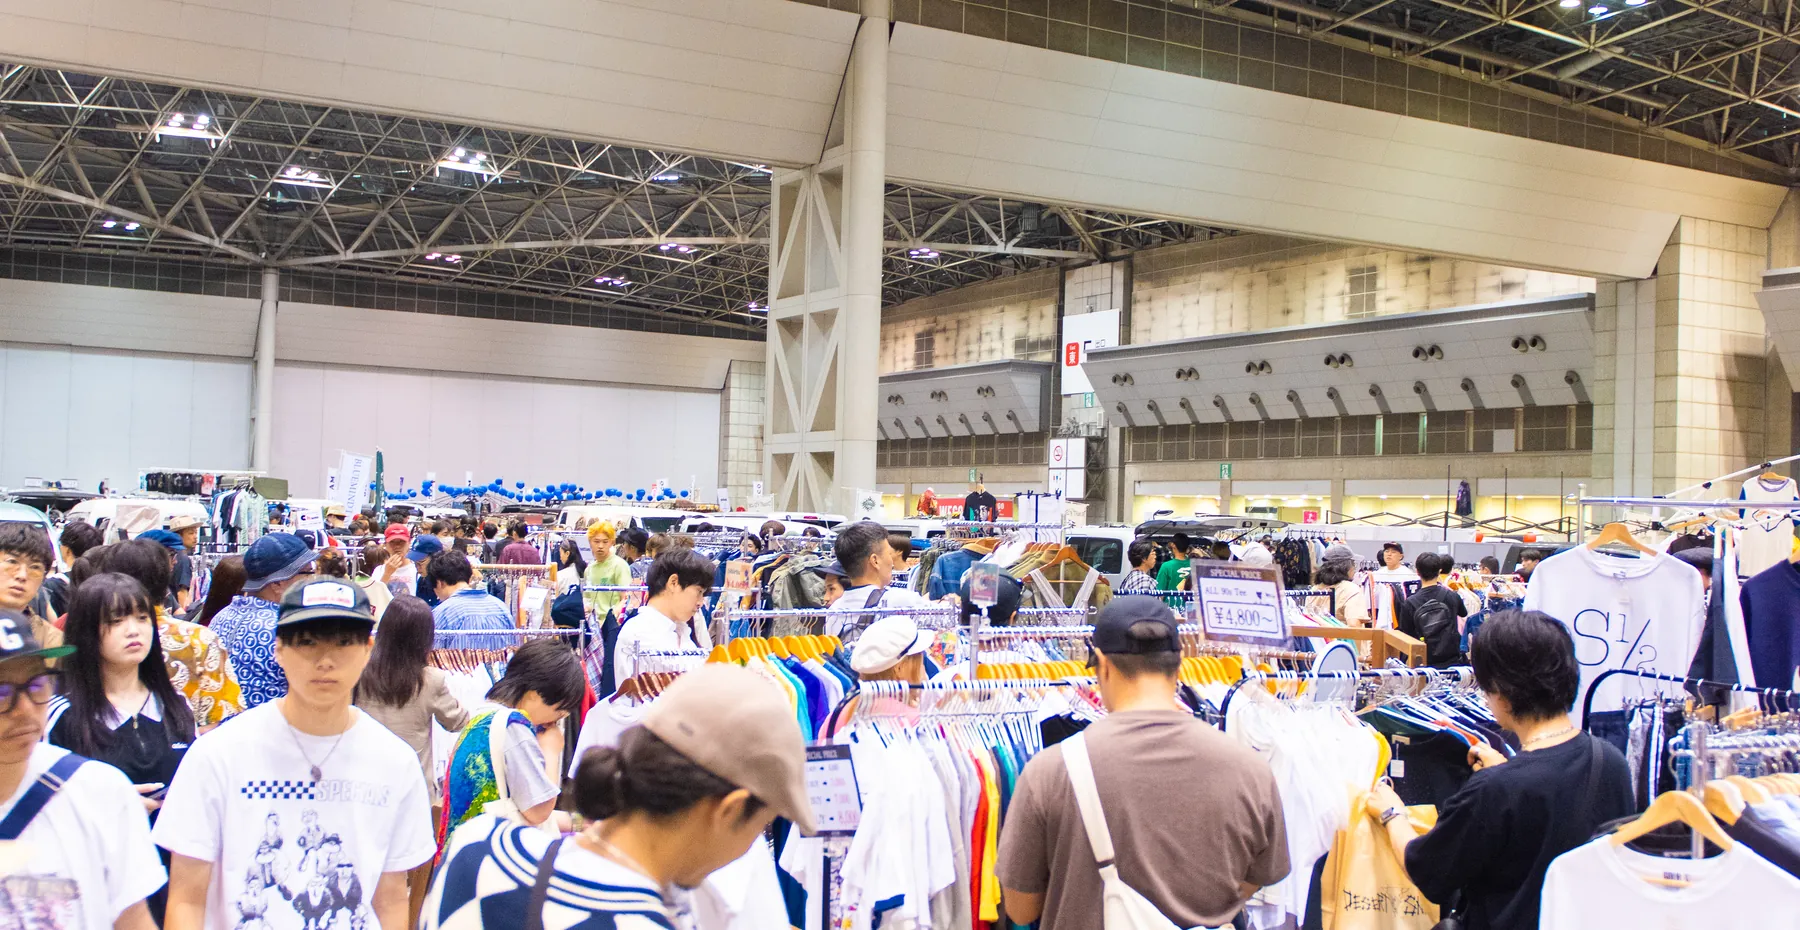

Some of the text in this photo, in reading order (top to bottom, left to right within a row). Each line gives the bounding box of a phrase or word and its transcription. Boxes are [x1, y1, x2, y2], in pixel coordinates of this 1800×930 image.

[1068, 351, 1076, 364] 東
[1210, 568, 1261, 580] SPECIAL PRICE
[805, 750, 822, 760] PECIAL
